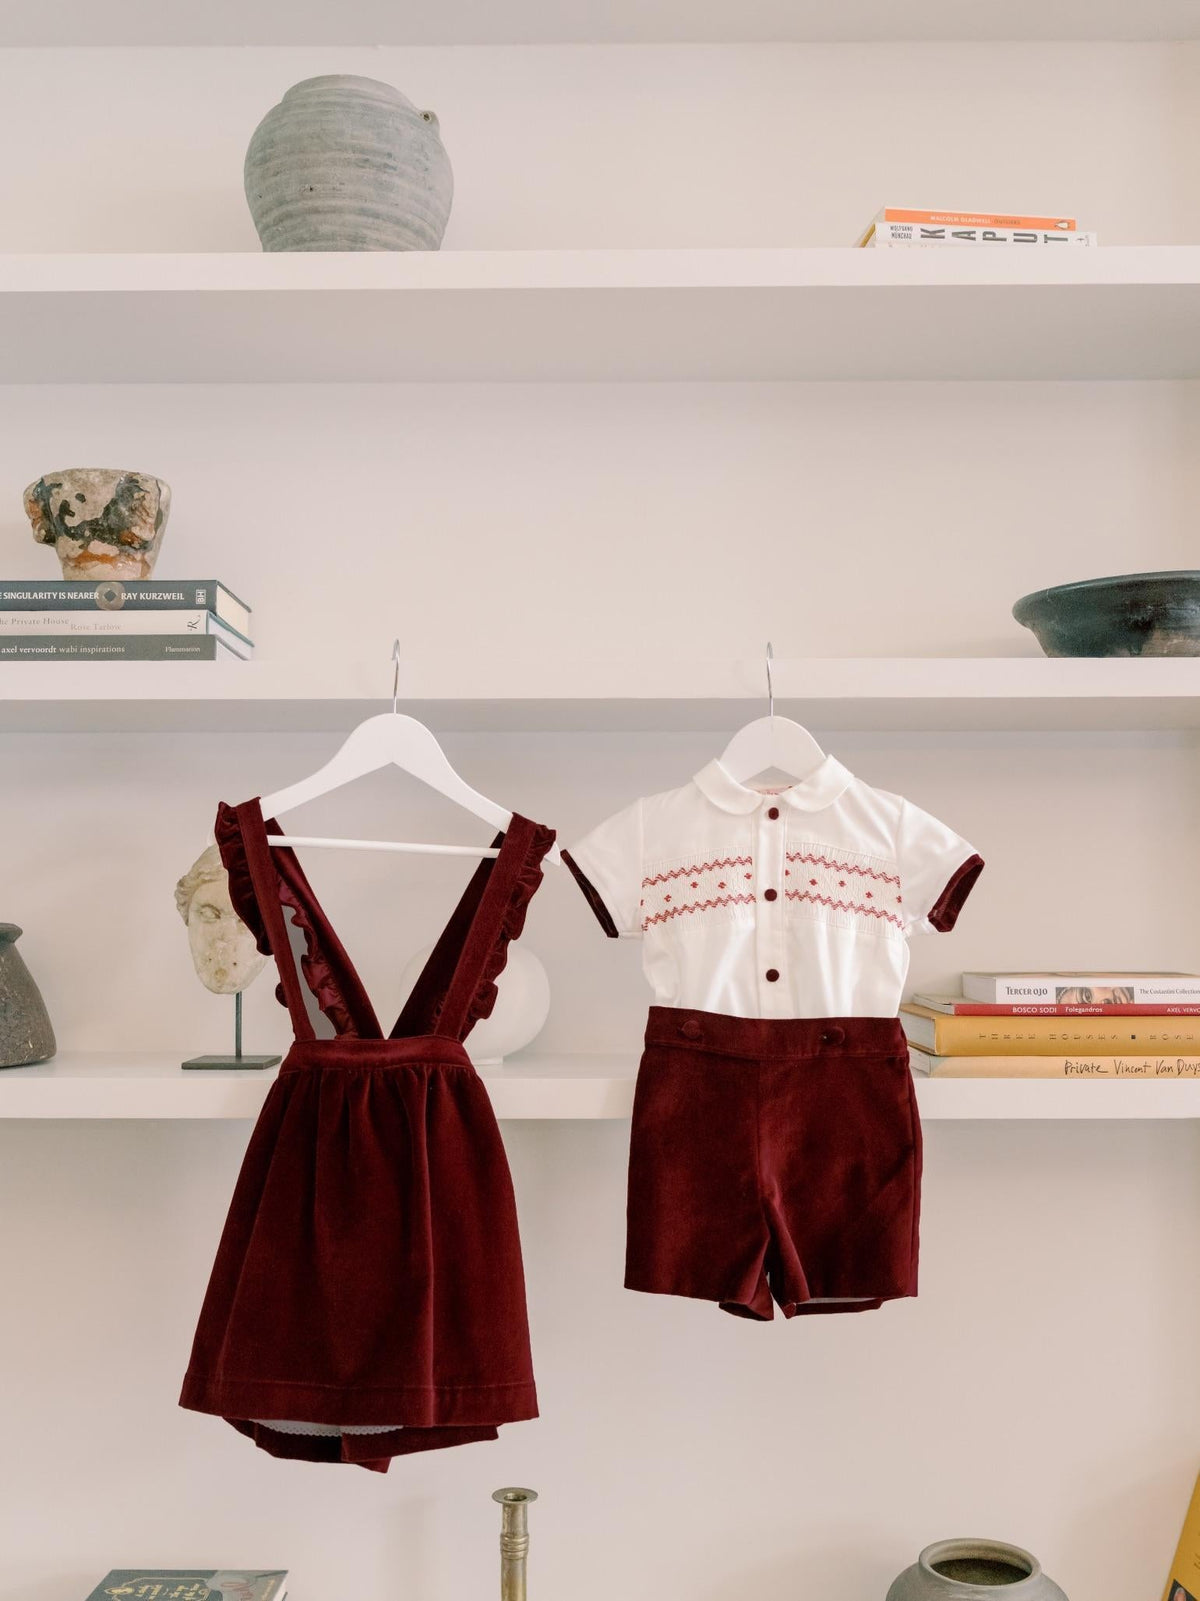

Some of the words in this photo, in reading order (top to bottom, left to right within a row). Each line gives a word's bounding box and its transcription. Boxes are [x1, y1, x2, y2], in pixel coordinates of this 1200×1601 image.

[920, 228, 1068, 244] KAPUT
[2, 646, 17, 654] axel
[20, 646, 56, 654] vervoordt
[80, 646, 125, 654] inspirations
[1006, 986, 1032, 996] TERCER
[1064, 1060, 1108, 1075] Private
[1114, 1060, 1152, 1075] Vincent
[1156, 1060, 1174, 1075] Van
